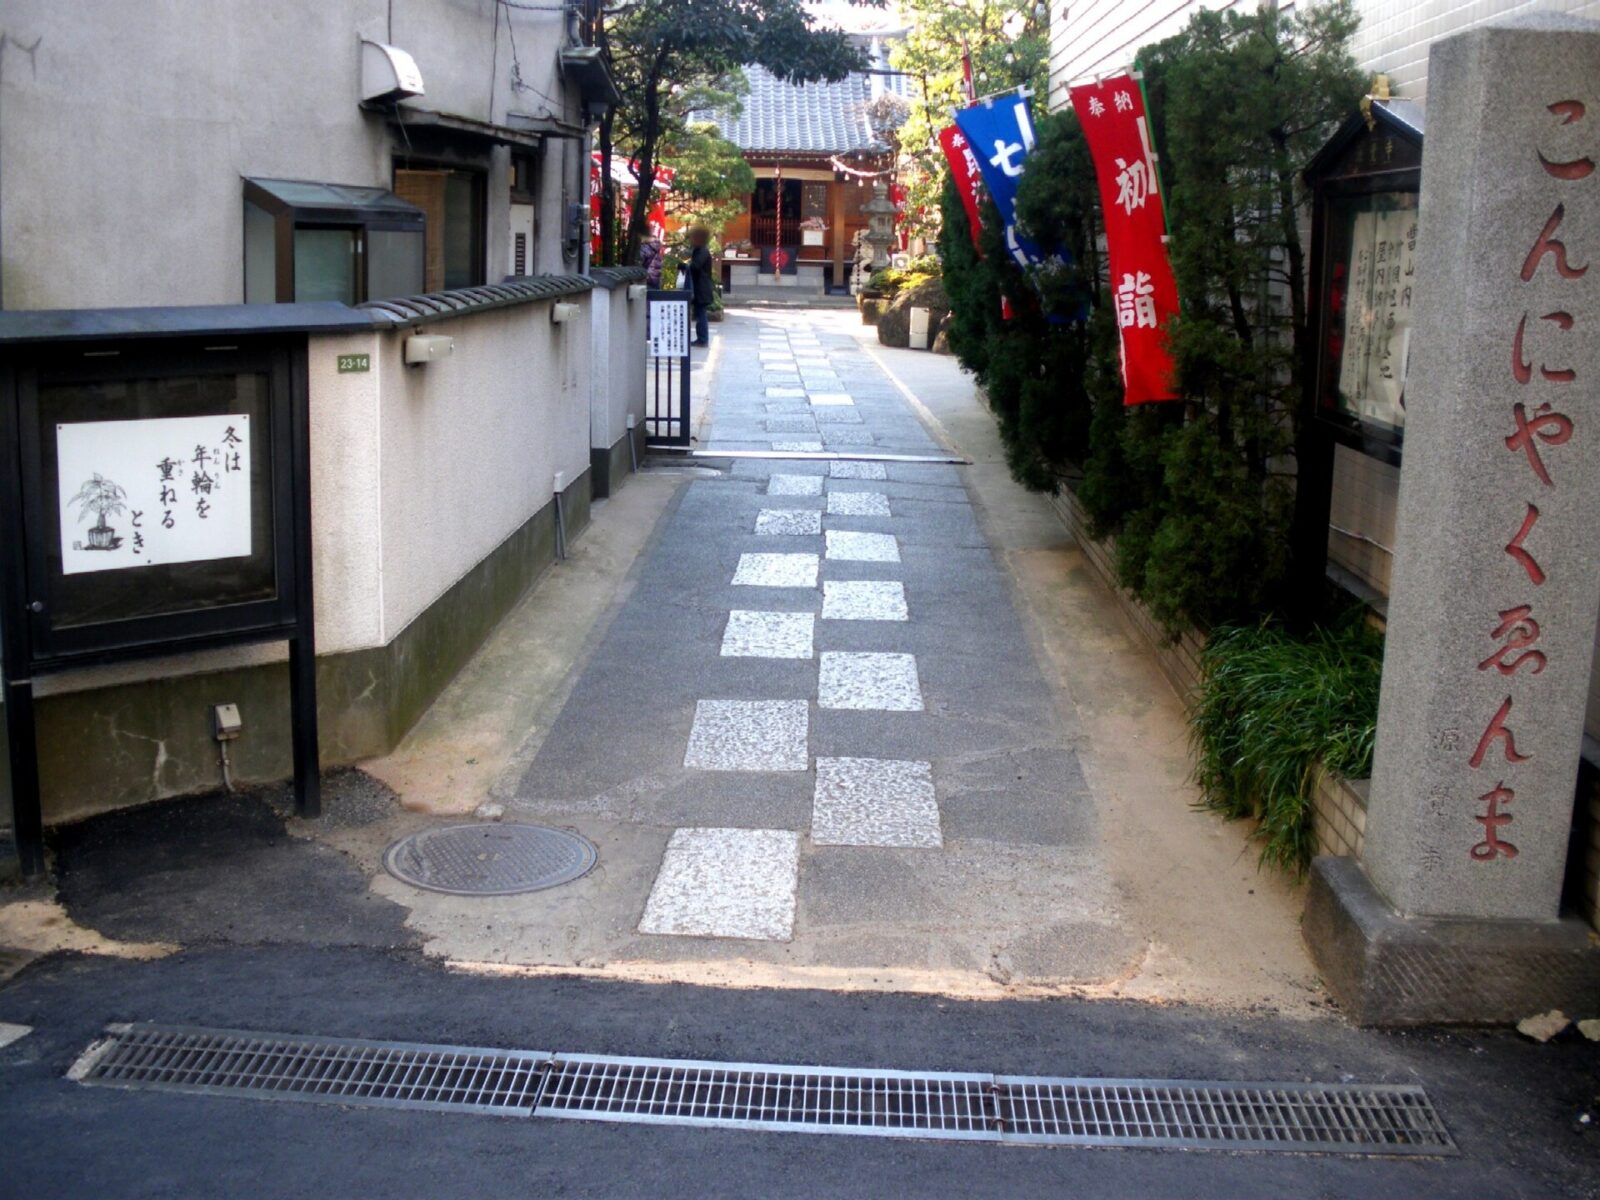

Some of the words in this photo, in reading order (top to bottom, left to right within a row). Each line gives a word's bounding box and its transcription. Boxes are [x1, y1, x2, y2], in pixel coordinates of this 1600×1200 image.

[1088, 90, 1135, 118] 奉納
[1115, 157, 1158, 329] 初詣
[191, 444, 214, 519] 年輪を
[222, 425, 242, 473] 冬は
[1469, 99, 1596, 862] こんにやくゑんま
[156, 456, 178, 529] 重ねる
[131, 510, 144, 554] とき
